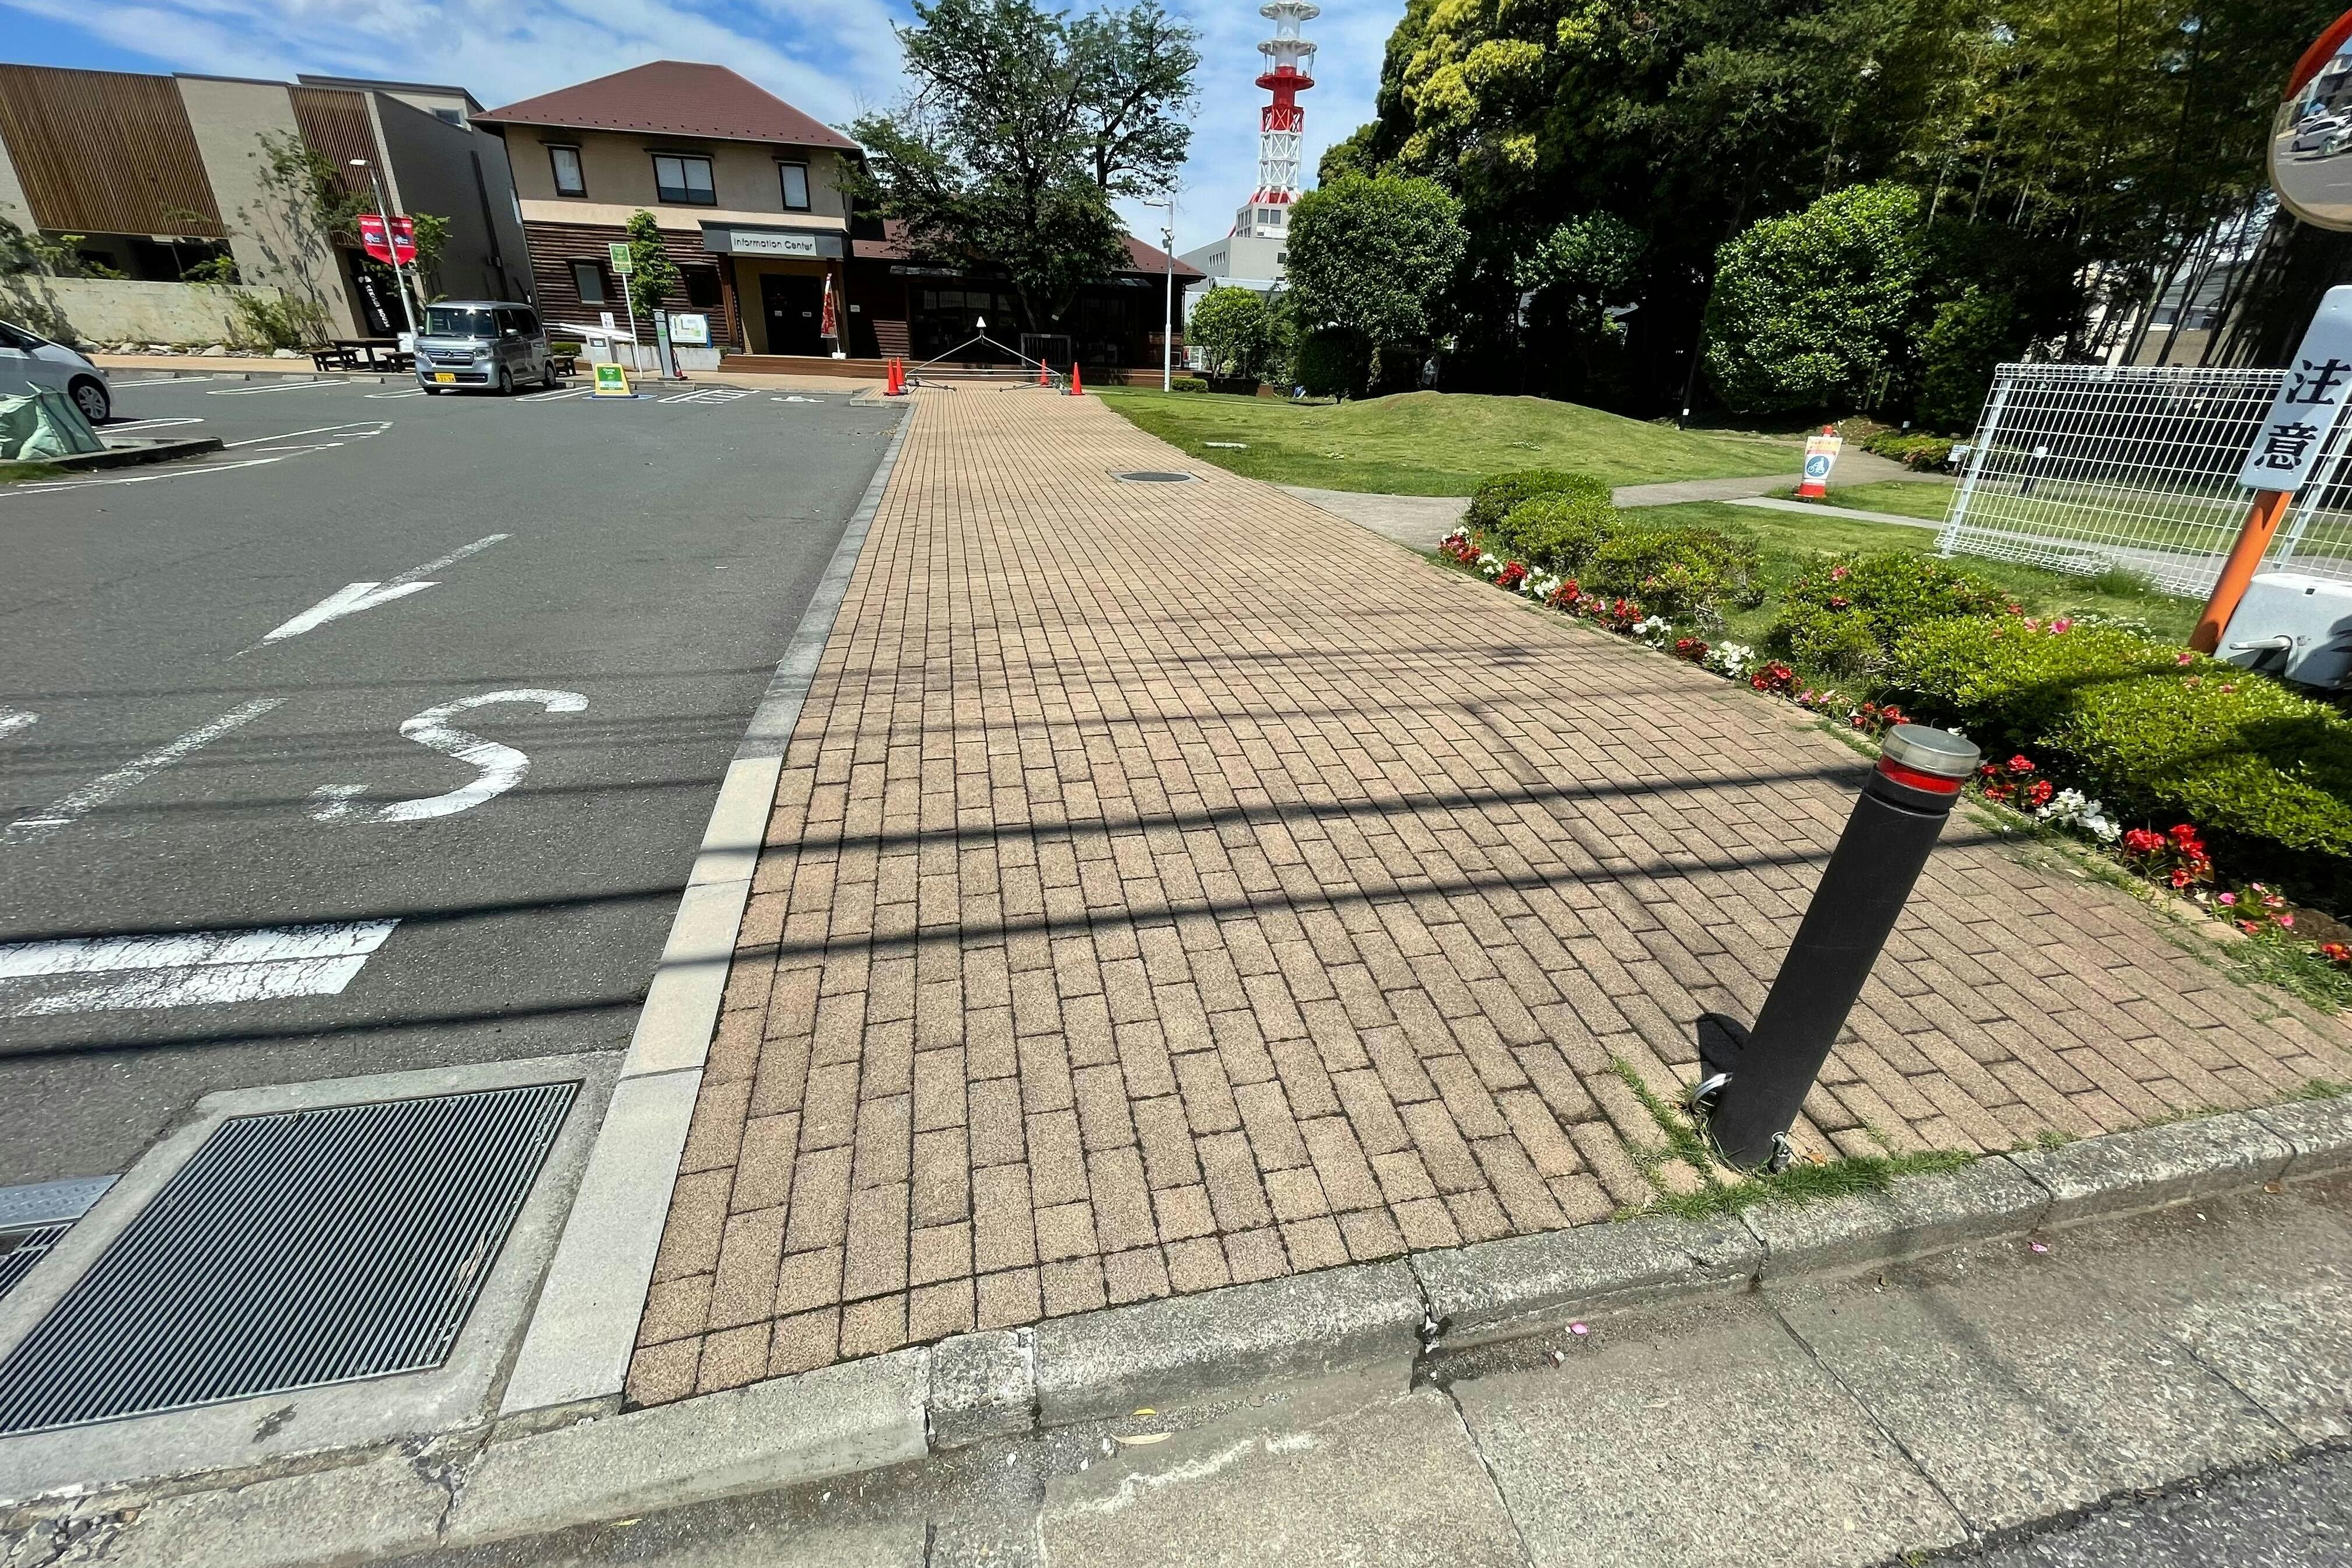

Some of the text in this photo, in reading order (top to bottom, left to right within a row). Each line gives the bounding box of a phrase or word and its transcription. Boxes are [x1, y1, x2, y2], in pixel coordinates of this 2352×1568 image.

[733, 238, 813, 251] Information Center
[2254, 359, 2351, 470] 注意
